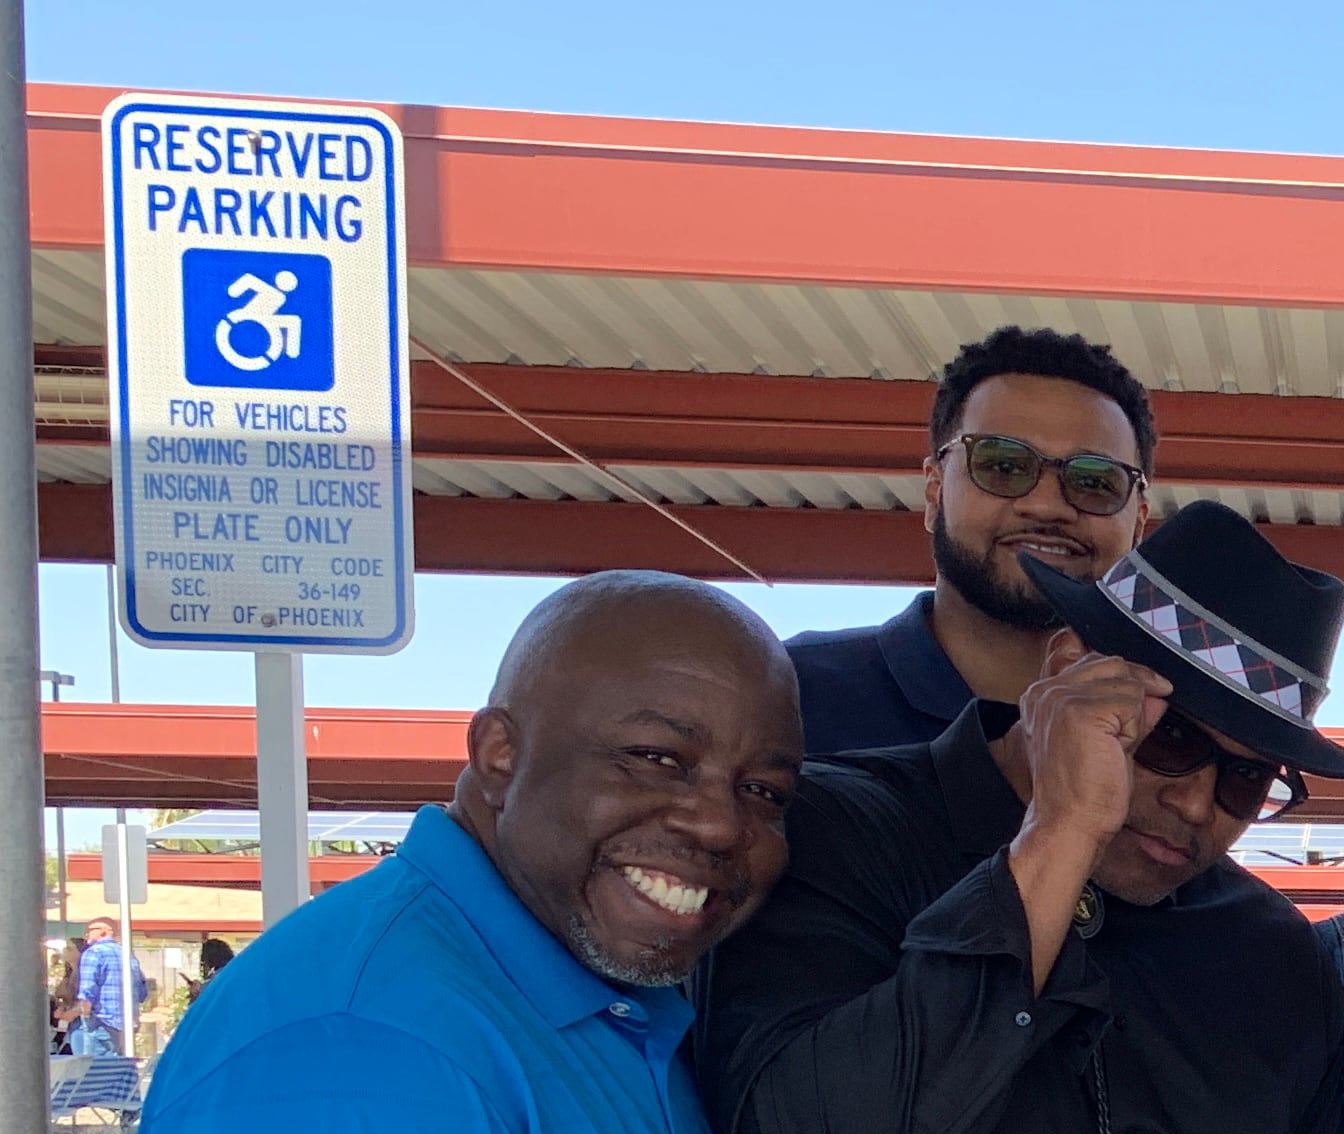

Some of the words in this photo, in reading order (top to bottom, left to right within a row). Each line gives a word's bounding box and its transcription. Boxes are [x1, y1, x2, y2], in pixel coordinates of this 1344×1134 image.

[133, 122, 373, 181] RESERVED
[148, 185, 361, 242] PARKING
[170, 400, 214, 427] FOR
[236, 403, 346, 433] VEHICLES
[148, 438, 246, 466] SHOWING
[265, 441, 374, 471] DISABLED
[144, 474, 230, 501] INSIGNIA
[251, 477, 278, 504] OR
[296, 480, 380, 508] LICENSE
[174, 512, 259, 541] PLATE
[285, 516, 351, 544] ONLY
[146, 552, 232, 570] PHOENIX
[262, 555, 304, 573] CITY
[331, 558, 382, 576] CODE
[298, 581, 361, 601] 36-149
[170, 604, 209, 622] CITY
[233, 606, 255, 624] OF
[279, 608, 363, 626] PHOENIX
